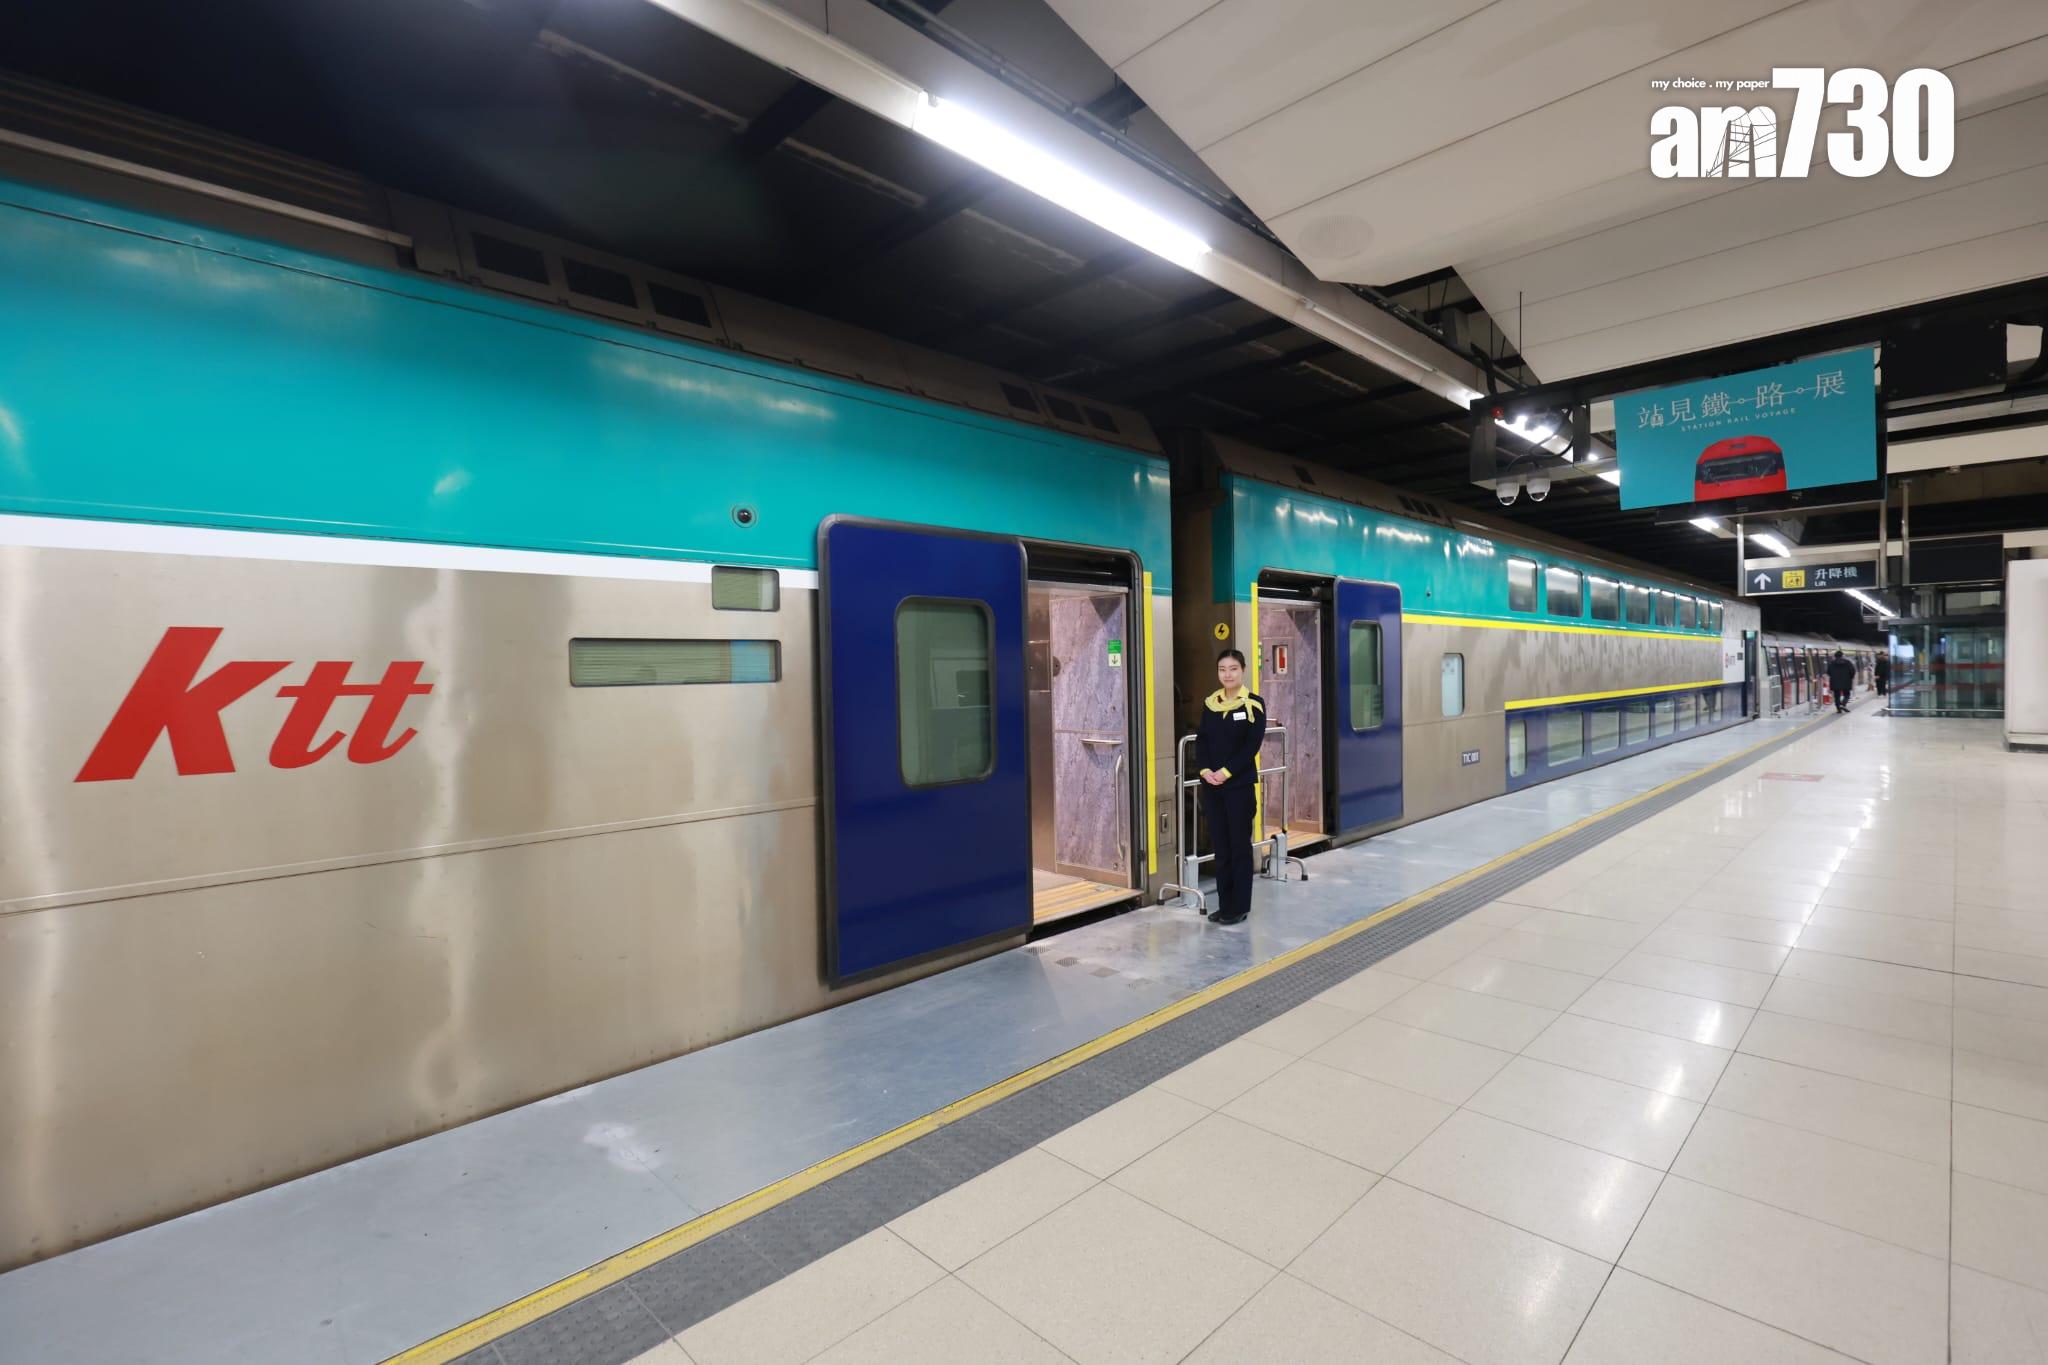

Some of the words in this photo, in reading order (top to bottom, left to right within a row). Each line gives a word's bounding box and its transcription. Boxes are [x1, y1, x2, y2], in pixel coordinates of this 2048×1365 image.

[1681, 420, 1722, 432] STATION
[1727, 416, 1750, 424] RAIL
[1755, 408, 1796, 419] VOYAGE
[1815, 566, 1858, 580] 升降機
